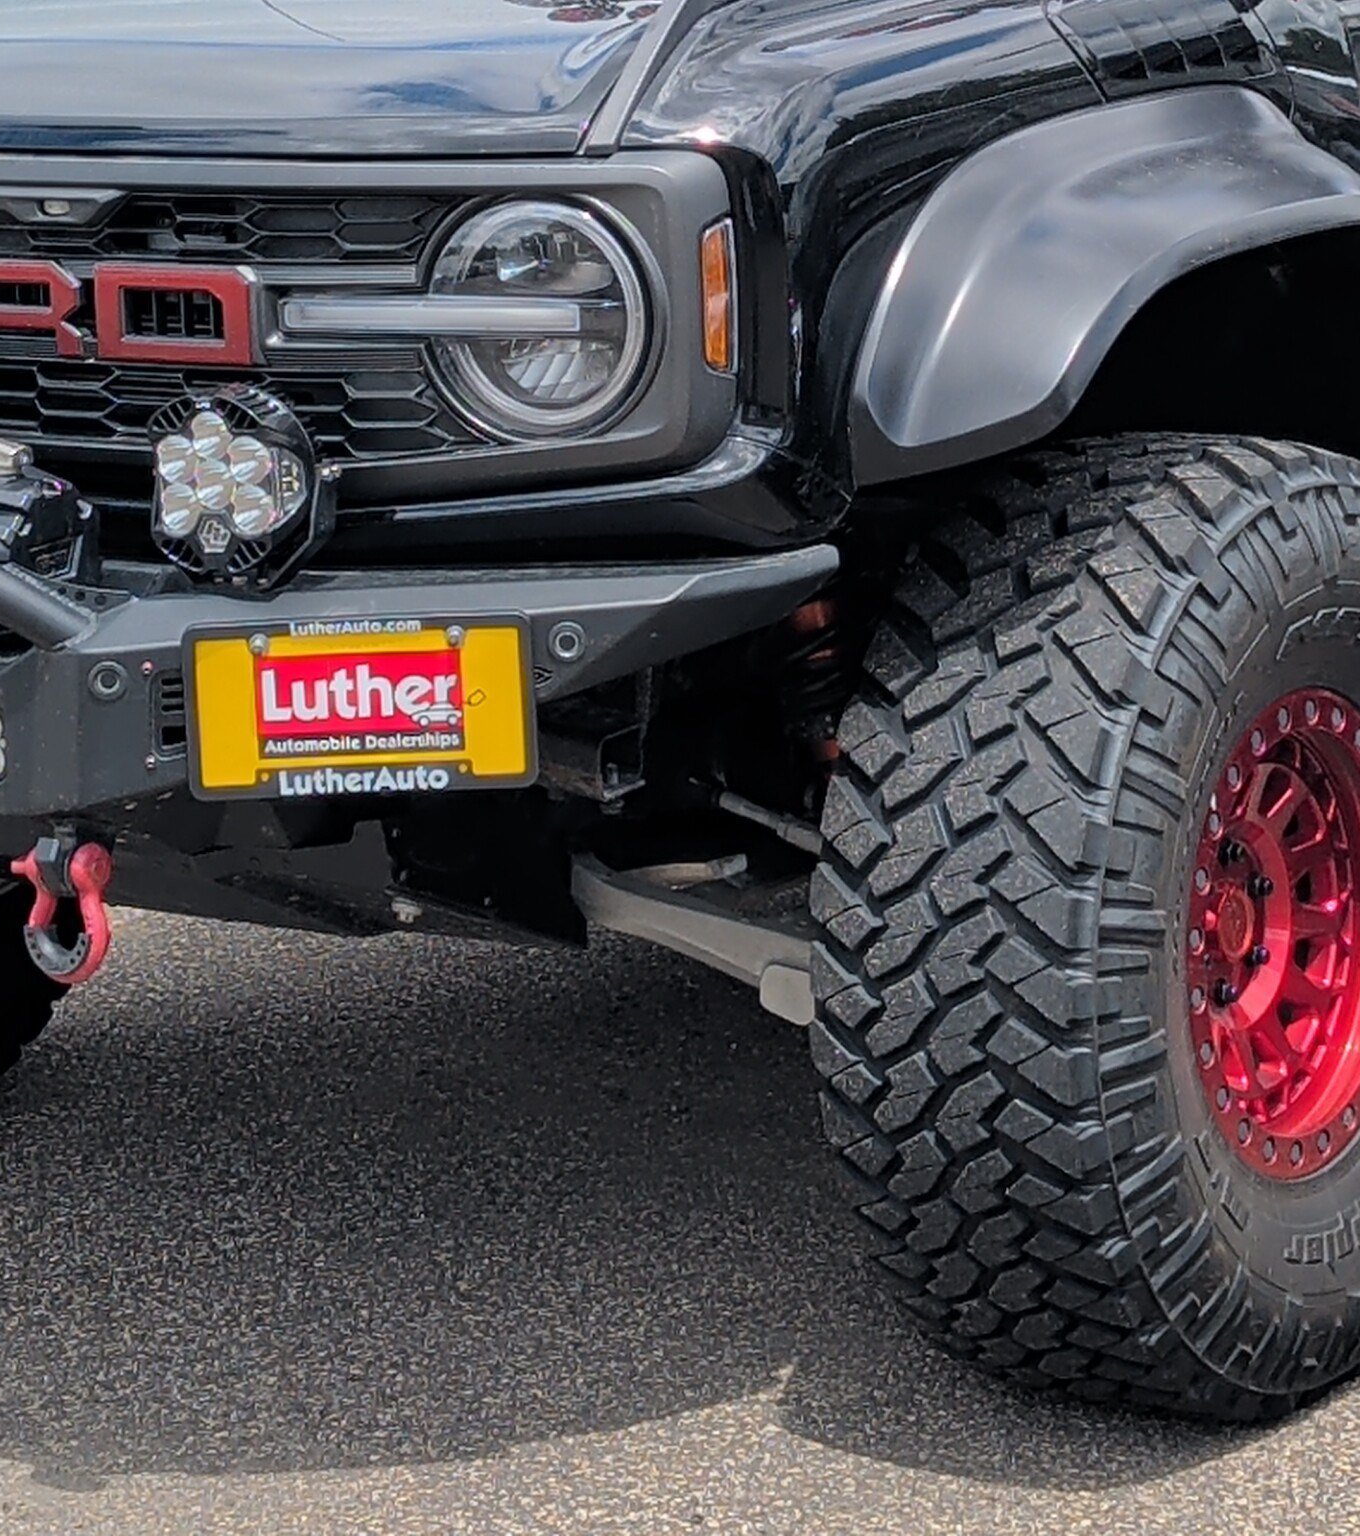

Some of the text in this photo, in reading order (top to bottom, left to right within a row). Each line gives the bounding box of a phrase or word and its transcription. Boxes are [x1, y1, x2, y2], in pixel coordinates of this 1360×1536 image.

[290, 619, 422, 638] LutherAuto.com
[260, 663, 458, 724] Luther
[264, 731, 460, 754] Automobile Dealerships
[278, 766, 450, 797] LutherAuto
